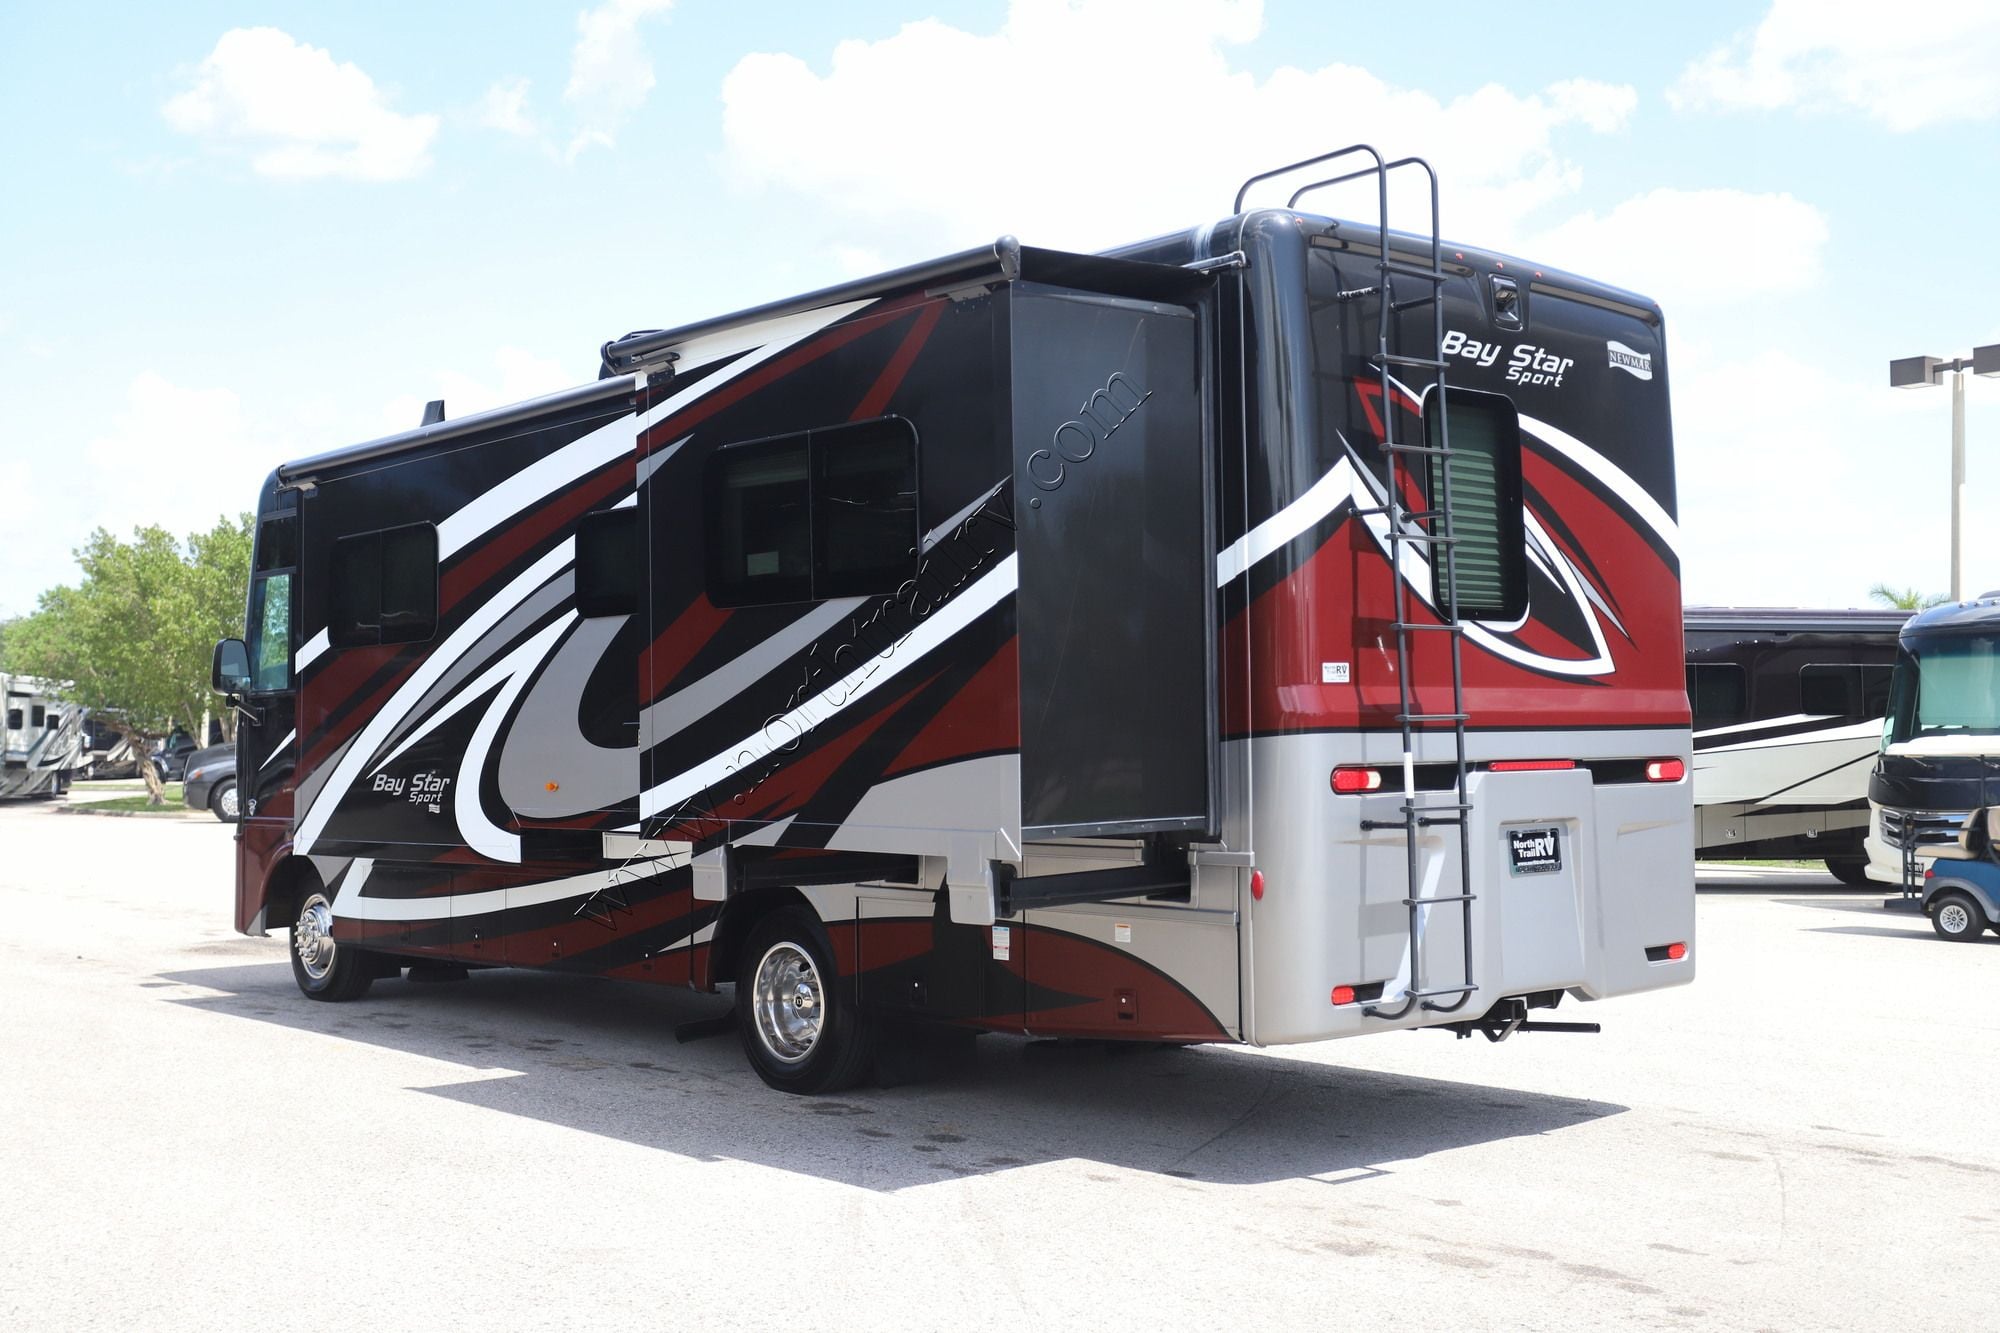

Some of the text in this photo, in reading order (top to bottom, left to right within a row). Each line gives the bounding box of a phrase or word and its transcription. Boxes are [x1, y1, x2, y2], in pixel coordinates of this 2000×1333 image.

[1441, 330, 1573, 374] Bay Star
[1609, 350, 1651, 371] NEWMAR
[1506, 367, 1563, 386] Sport
[373, 773, 450, 795] Bay Star
[409, 792, 443, 805] Sport
[1513, 840, 1535, 849] North
[1518, 849, 1536, 858] Trail
[1534, 837, 1555, 857] RV
